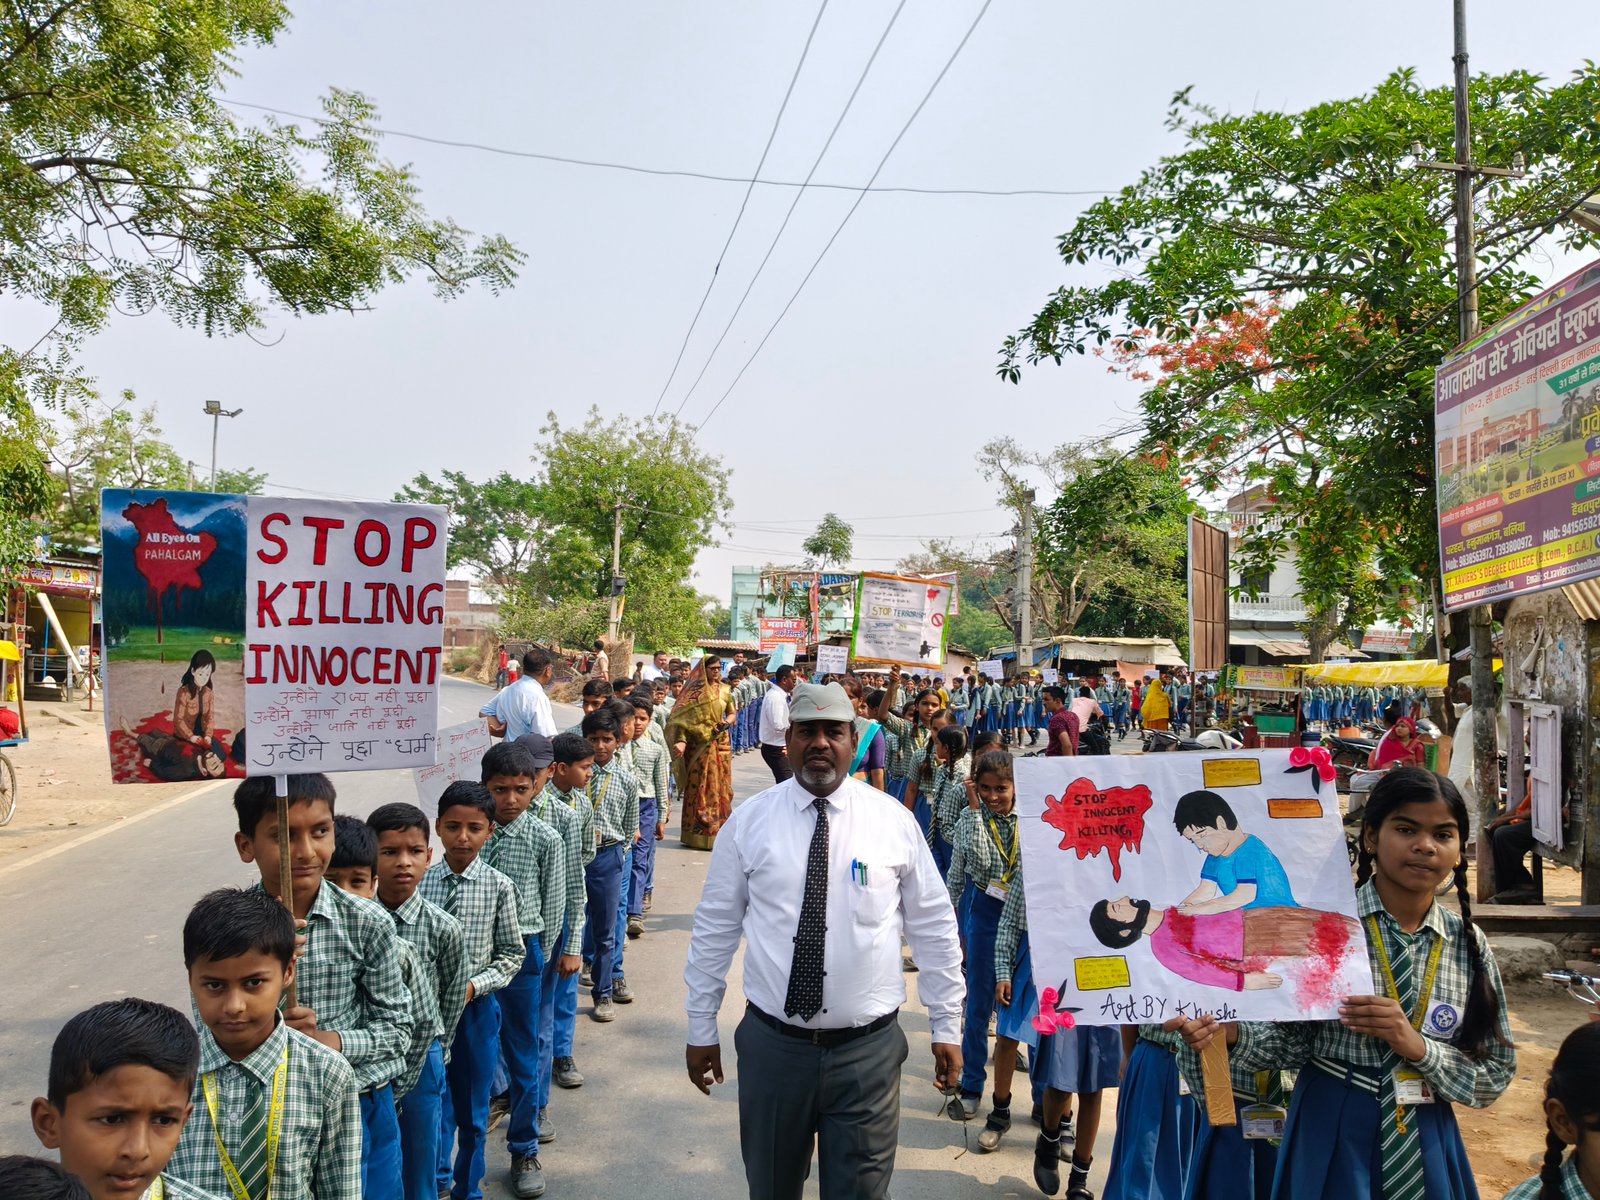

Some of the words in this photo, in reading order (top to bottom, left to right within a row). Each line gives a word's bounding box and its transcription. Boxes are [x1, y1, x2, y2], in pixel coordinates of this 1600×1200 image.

[1438, 354, 1485, 402] आवासीय
[1488, 339, 1509, 378] सेंट
[1511, 308, 1561, 366] जेवियर्स
[145, 533, 160, 543] All
[161, 533, 186, 545] Eyes
[187, 533, 201, 543] On
[256, 512, 437, 573] STOP
[1543, 525, 1559, 542] Mob:
[144, 549, 201, 561] PAHALGAM
[1483, 561, 1507, 578] DEGREE
[1507, 554, 1533, 571] COLLEGE
[257, 580, 444, 628] KILLING
[872, 606, 893, 617] STOP
[893, 609, 927, 620] TERRORISM
[246, 643, 442, 686] INNOCENT
[1073, 793, 1107, 806] STOP
[1082, 804, 1137, 819] INNOCENT
[1076, 823, 1132, 838] KILLING
[1100, 993, 1138, 1022] Art
[276, 1068, 287, 1105] SCHOOL
[271, 1107, 282, 1138] PUBLIC
